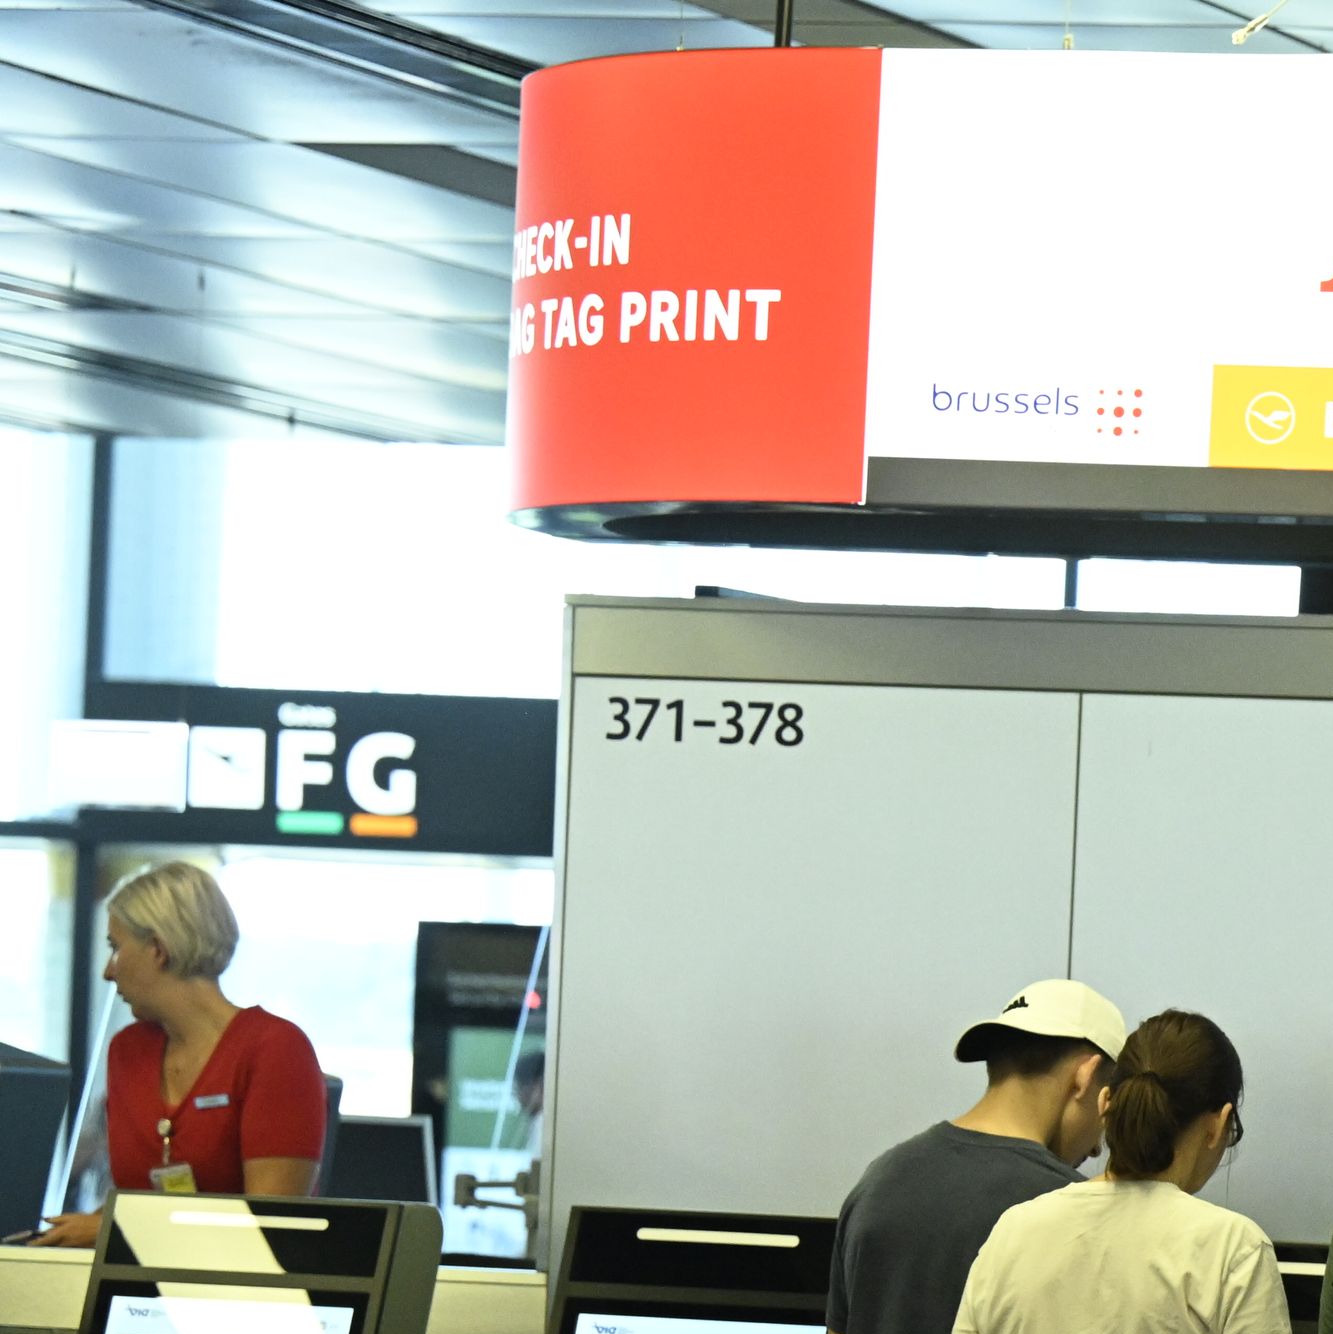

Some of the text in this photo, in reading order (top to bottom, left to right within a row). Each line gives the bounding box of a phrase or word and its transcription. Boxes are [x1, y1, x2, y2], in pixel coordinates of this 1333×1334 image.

[541, 293, 604, 349] TAG
[620, 289, 781, 342] PRINT
[933, 384, 1079, 416] brussels
[606, 697, 804, 746] 371-378
[276, 729, 417, 815] F G
